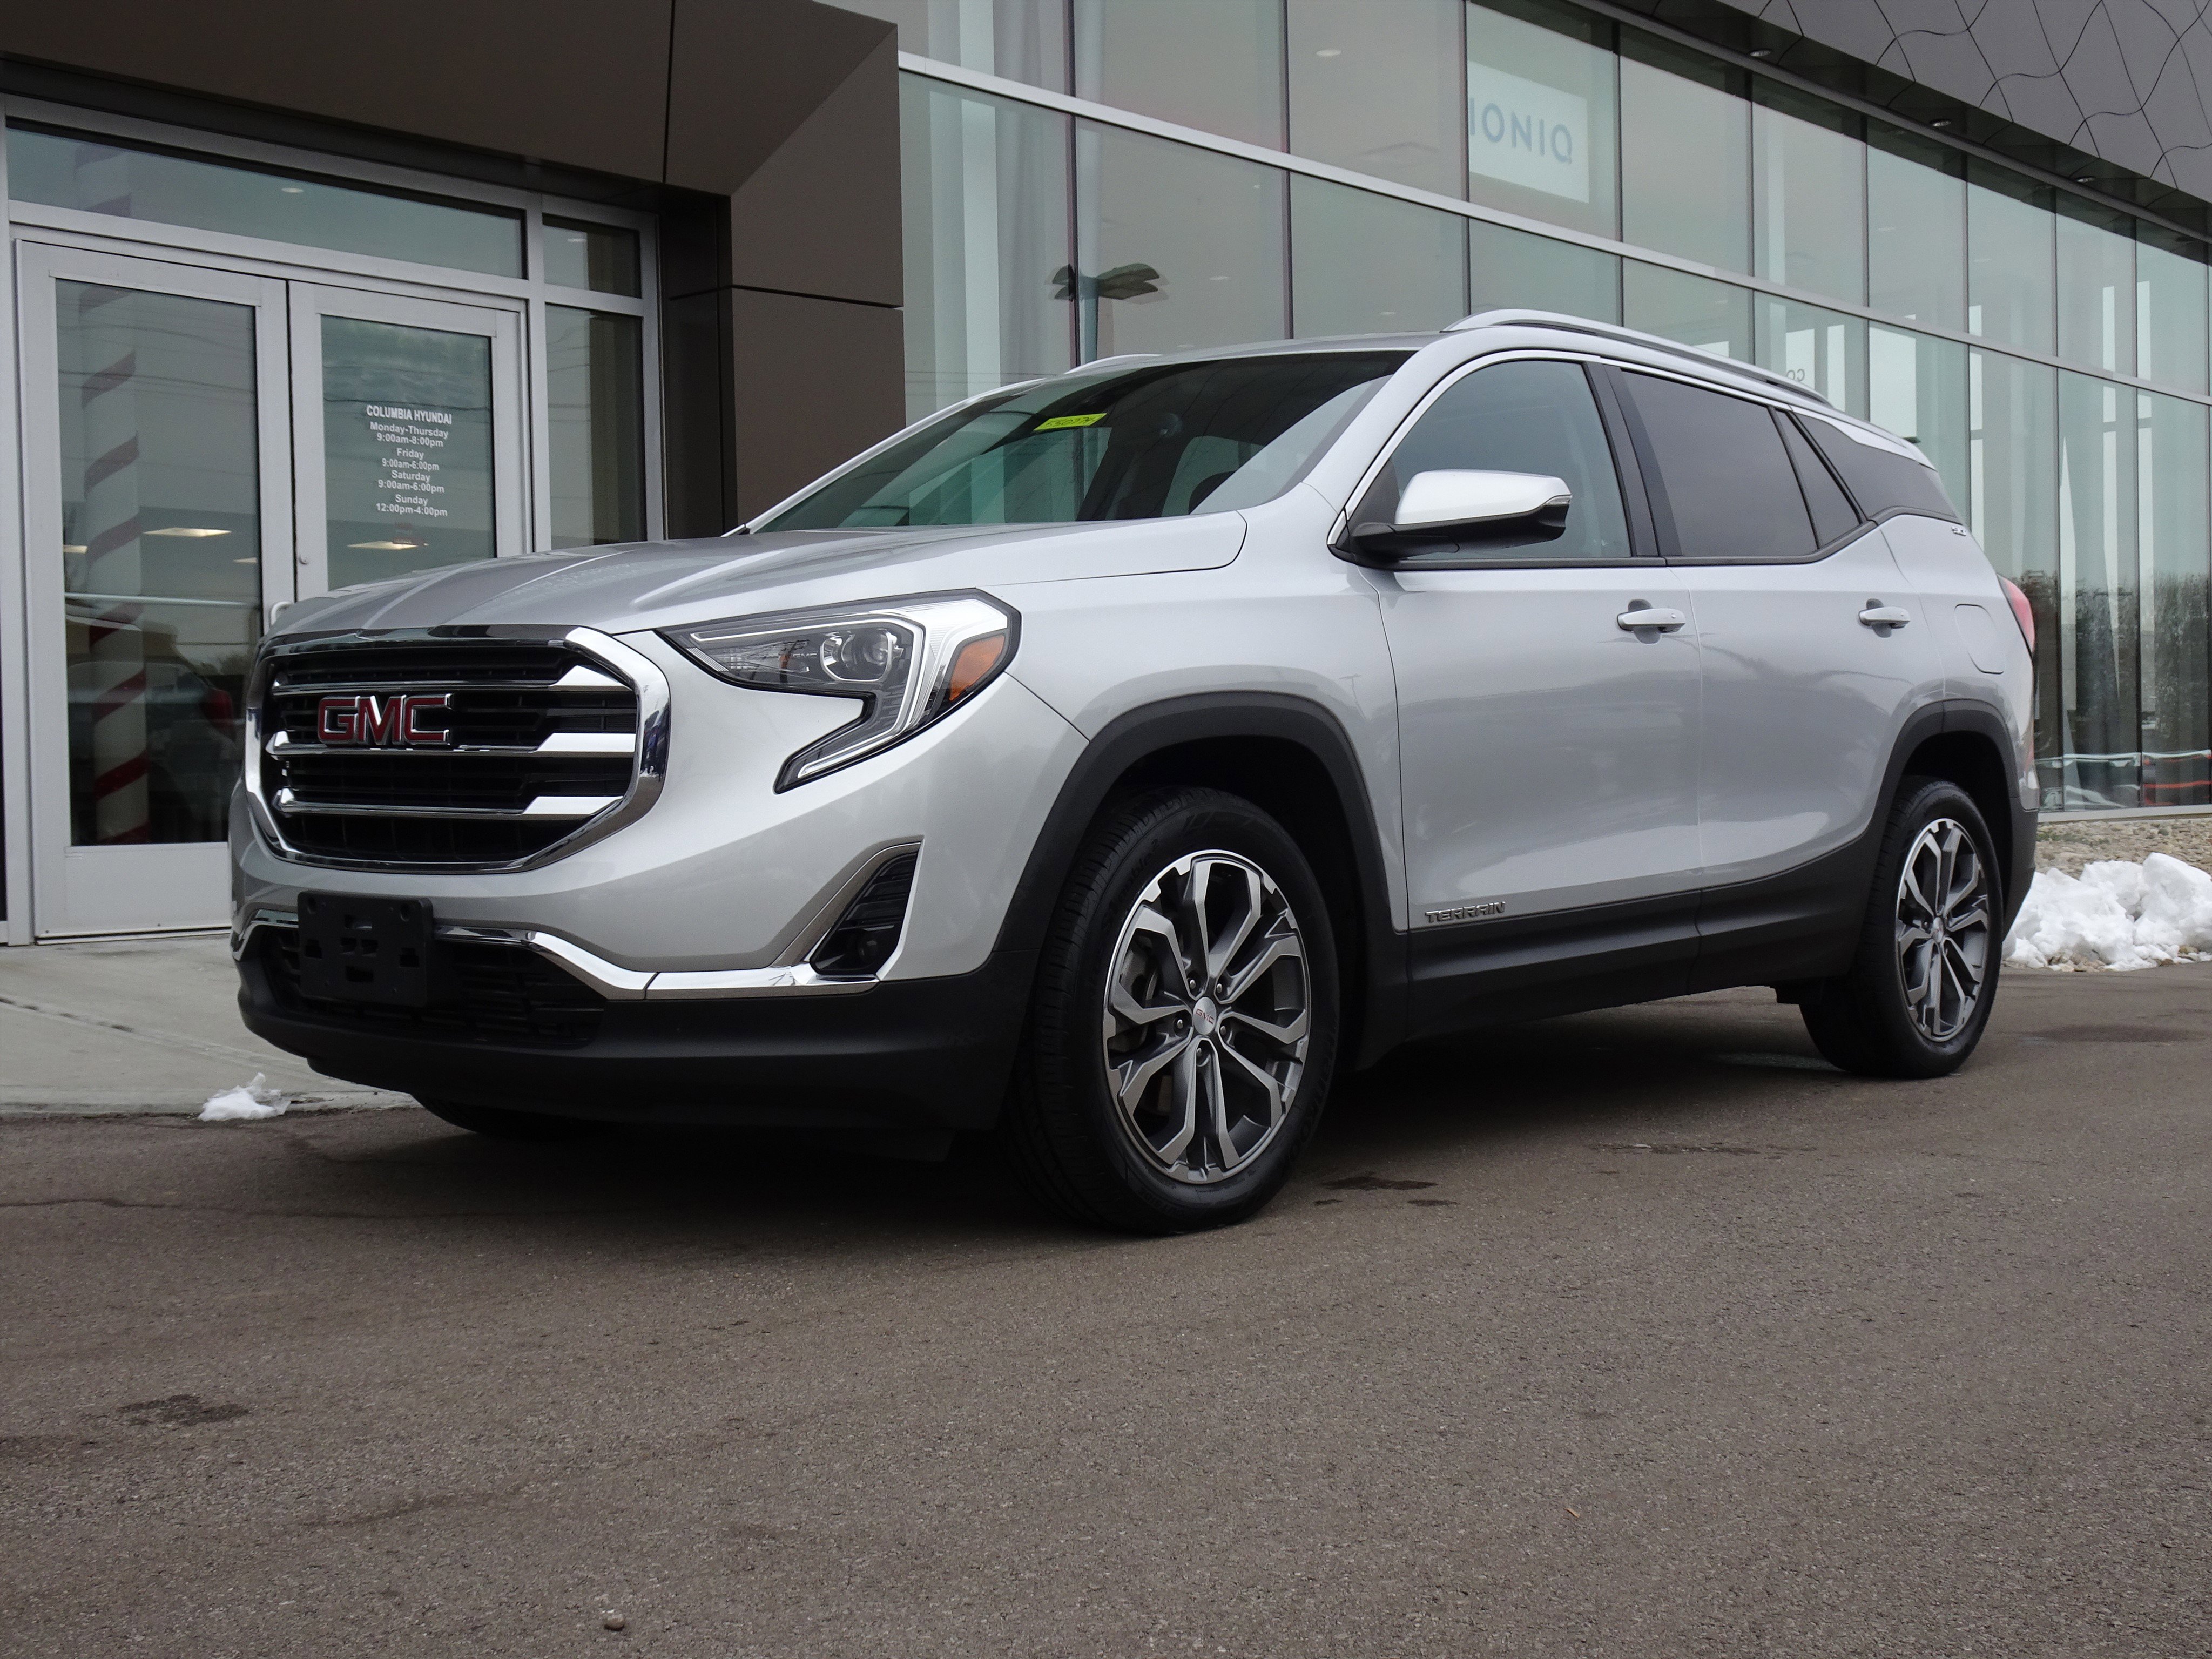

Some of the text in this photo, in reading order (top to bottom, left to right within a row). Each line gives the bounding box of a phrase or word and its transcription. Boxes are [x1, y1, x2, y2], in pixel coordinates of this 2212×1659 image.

[1468, 97, 1573, 164] IONIQ
[366, 404, 452, 425] COLUMBIA HYUNDAI
[370, 421, 448, 440] Monday-Thursday
[376, 433, 443, 448] 9:00am-8:00pm
[396, 448, 424, 460] Friday
[382, 458, 440, 471] 9:00am-6:00pm
[392, 470, 430, 483] Saturday
[378, 479, 444, 494] 9:00am-6:00pm
[395, 494, 428, 507] Sunday
[376, 503, 448, 517] 12:00pm-4:00pm
[318, 693, 453, 746] GMC
[1425, 901, 1506, 923] TERRAIN
[1196, 1008, 1214, 1024] GMC
